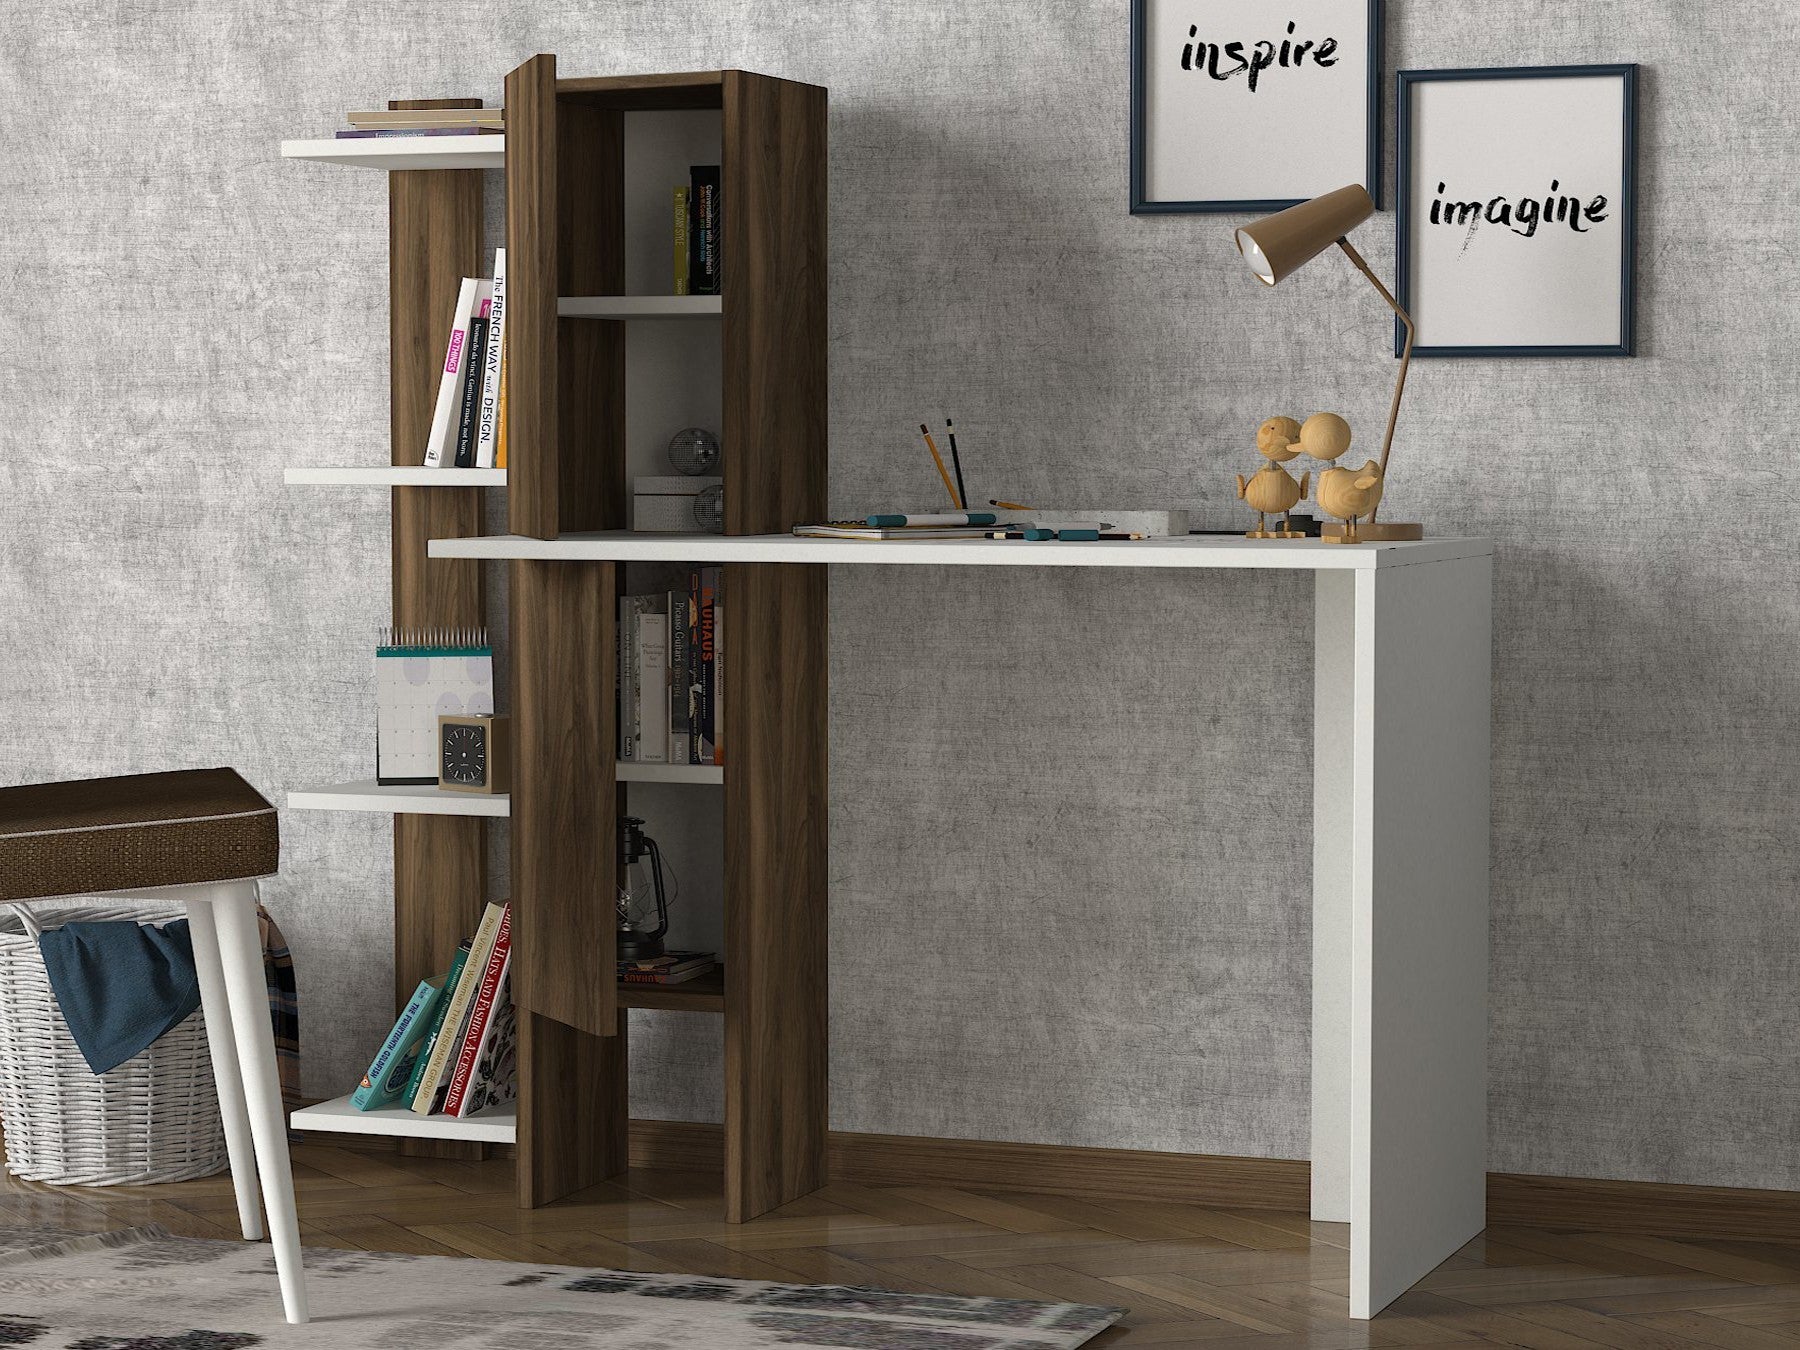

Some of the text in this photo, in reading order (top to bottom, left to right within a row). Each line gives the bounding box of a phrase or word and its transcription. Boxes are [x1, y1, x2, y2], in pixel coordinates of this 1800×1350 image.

[1181, 21, 1340, 93] inspire
[1429, 179, 1609, 262] imagine
[494, 275, 504, 292] The
[489, 294, 504, 342] FRENCH
[447, 331, 464, 372] 100 THINGS
[472, 323, 482, 352] leonardo
[471, 350, 479, 360] da
[487, 344, 500, 373] WAY
[466, 378, 476, 402] Genius
[485, 375, 494, 394] with
[461, 427, 470, 438] not
[480, 397, 494, 444] DESIGN.
[674, 601, 686, 630] Picasso
[701, 587, 714, 662] BAUHAUS
[674, 631, 686, 662] Guitars
[483, 917, 494, 936] Paul
[488, 946, 507, 976] HATS
[482, 976, 495, 998] AND
[449, 1009, 461, 1025] THE
[468, 998, 491, 1042] FASHION
[370, 1002, 420, 1079] THE FOURTEENTH GOLDFISH
[432, 1026, 453, 1066] WISEMAN
[448, 1041, 477, 1109] ACCESSORIES
